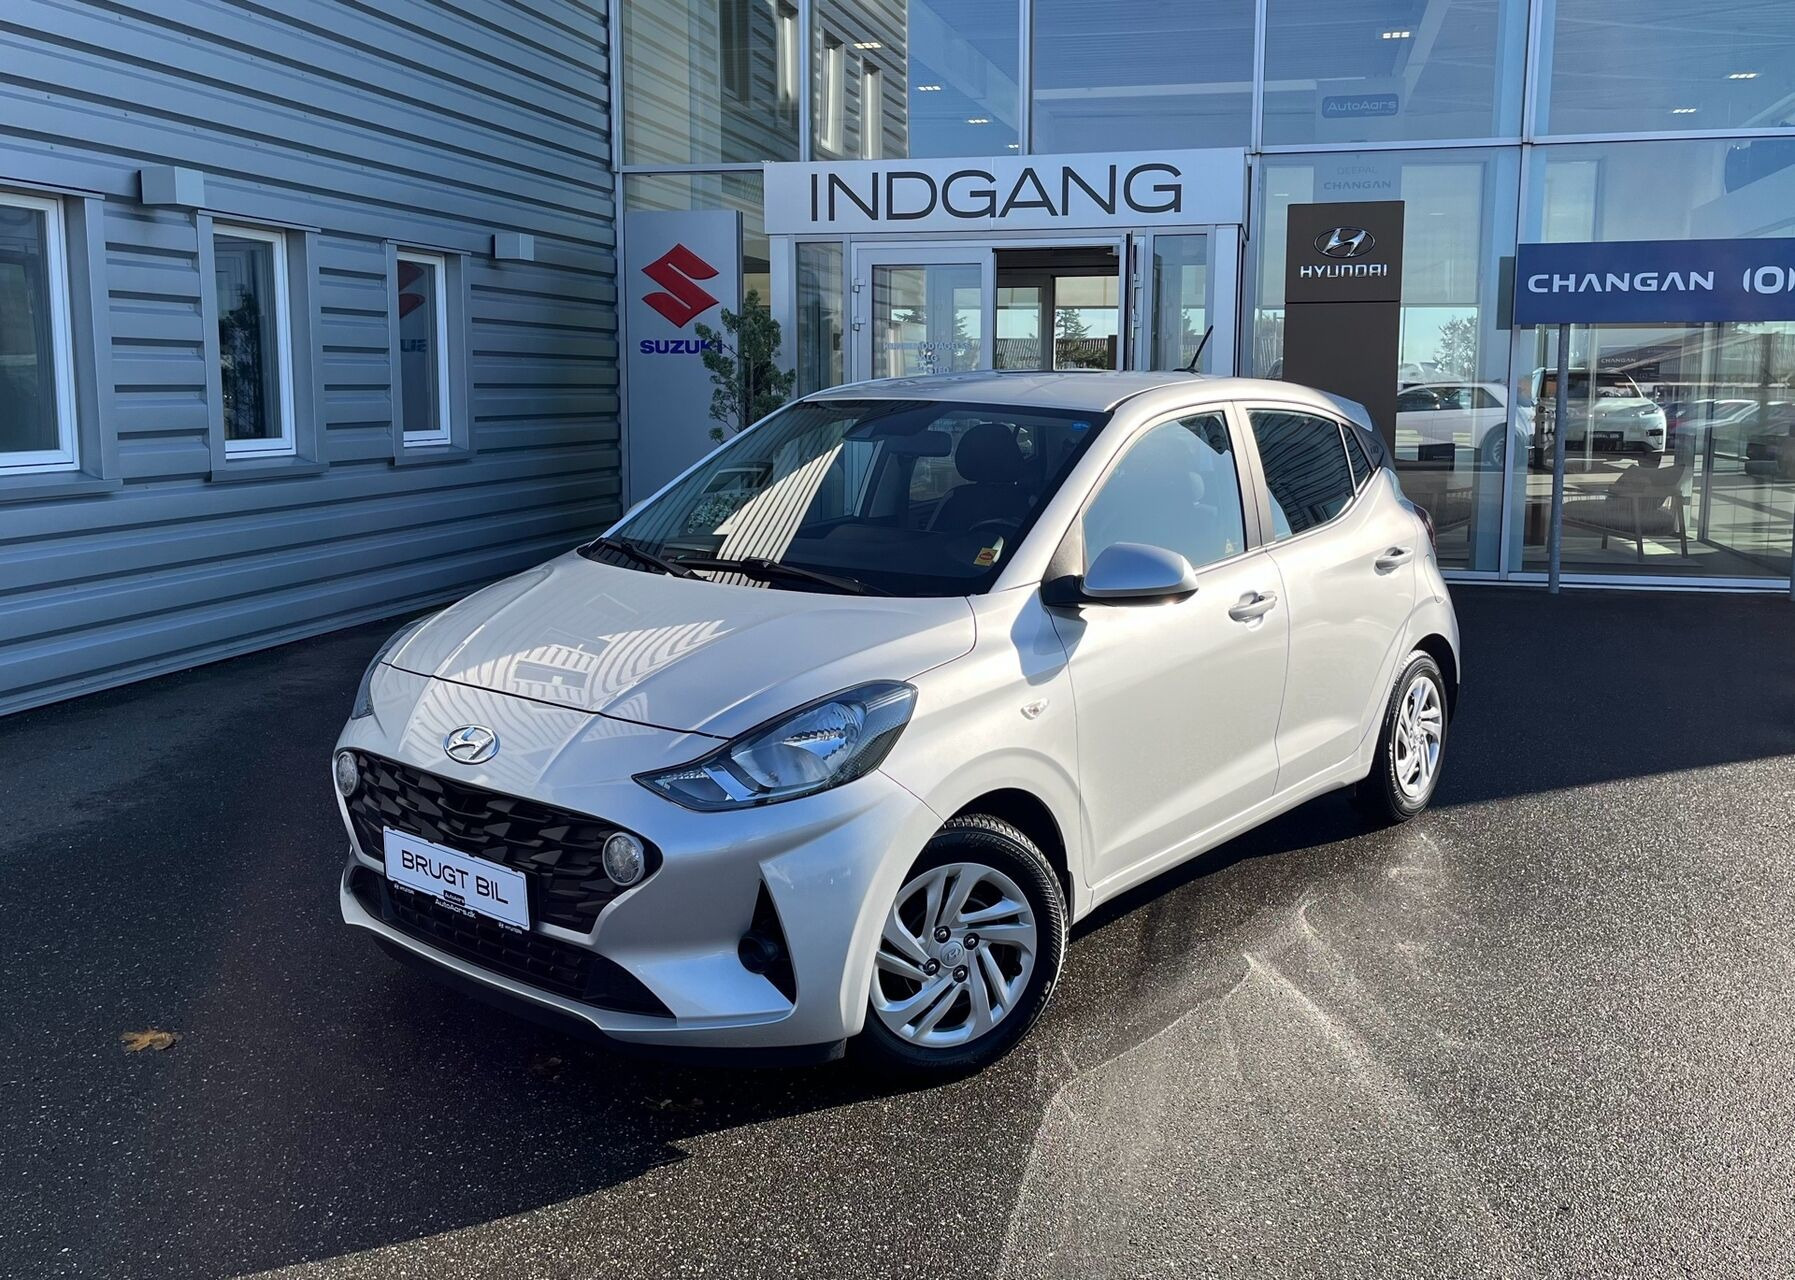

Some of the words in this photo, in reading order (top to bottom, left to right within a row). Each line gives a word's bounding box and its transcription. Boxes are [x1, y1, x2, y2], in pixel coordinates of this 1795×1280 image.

[810, 163, 1182, 222] INDGANG
[1323, 180, 1392, 190] CHANGAN
[1300, 263, 1388, 279] HYUNDAI
[1527, 271, 1714, 293] CHANGAN
[401, 849, 468, 889] BRUGT
[475, 875, 508, 904] BIL
